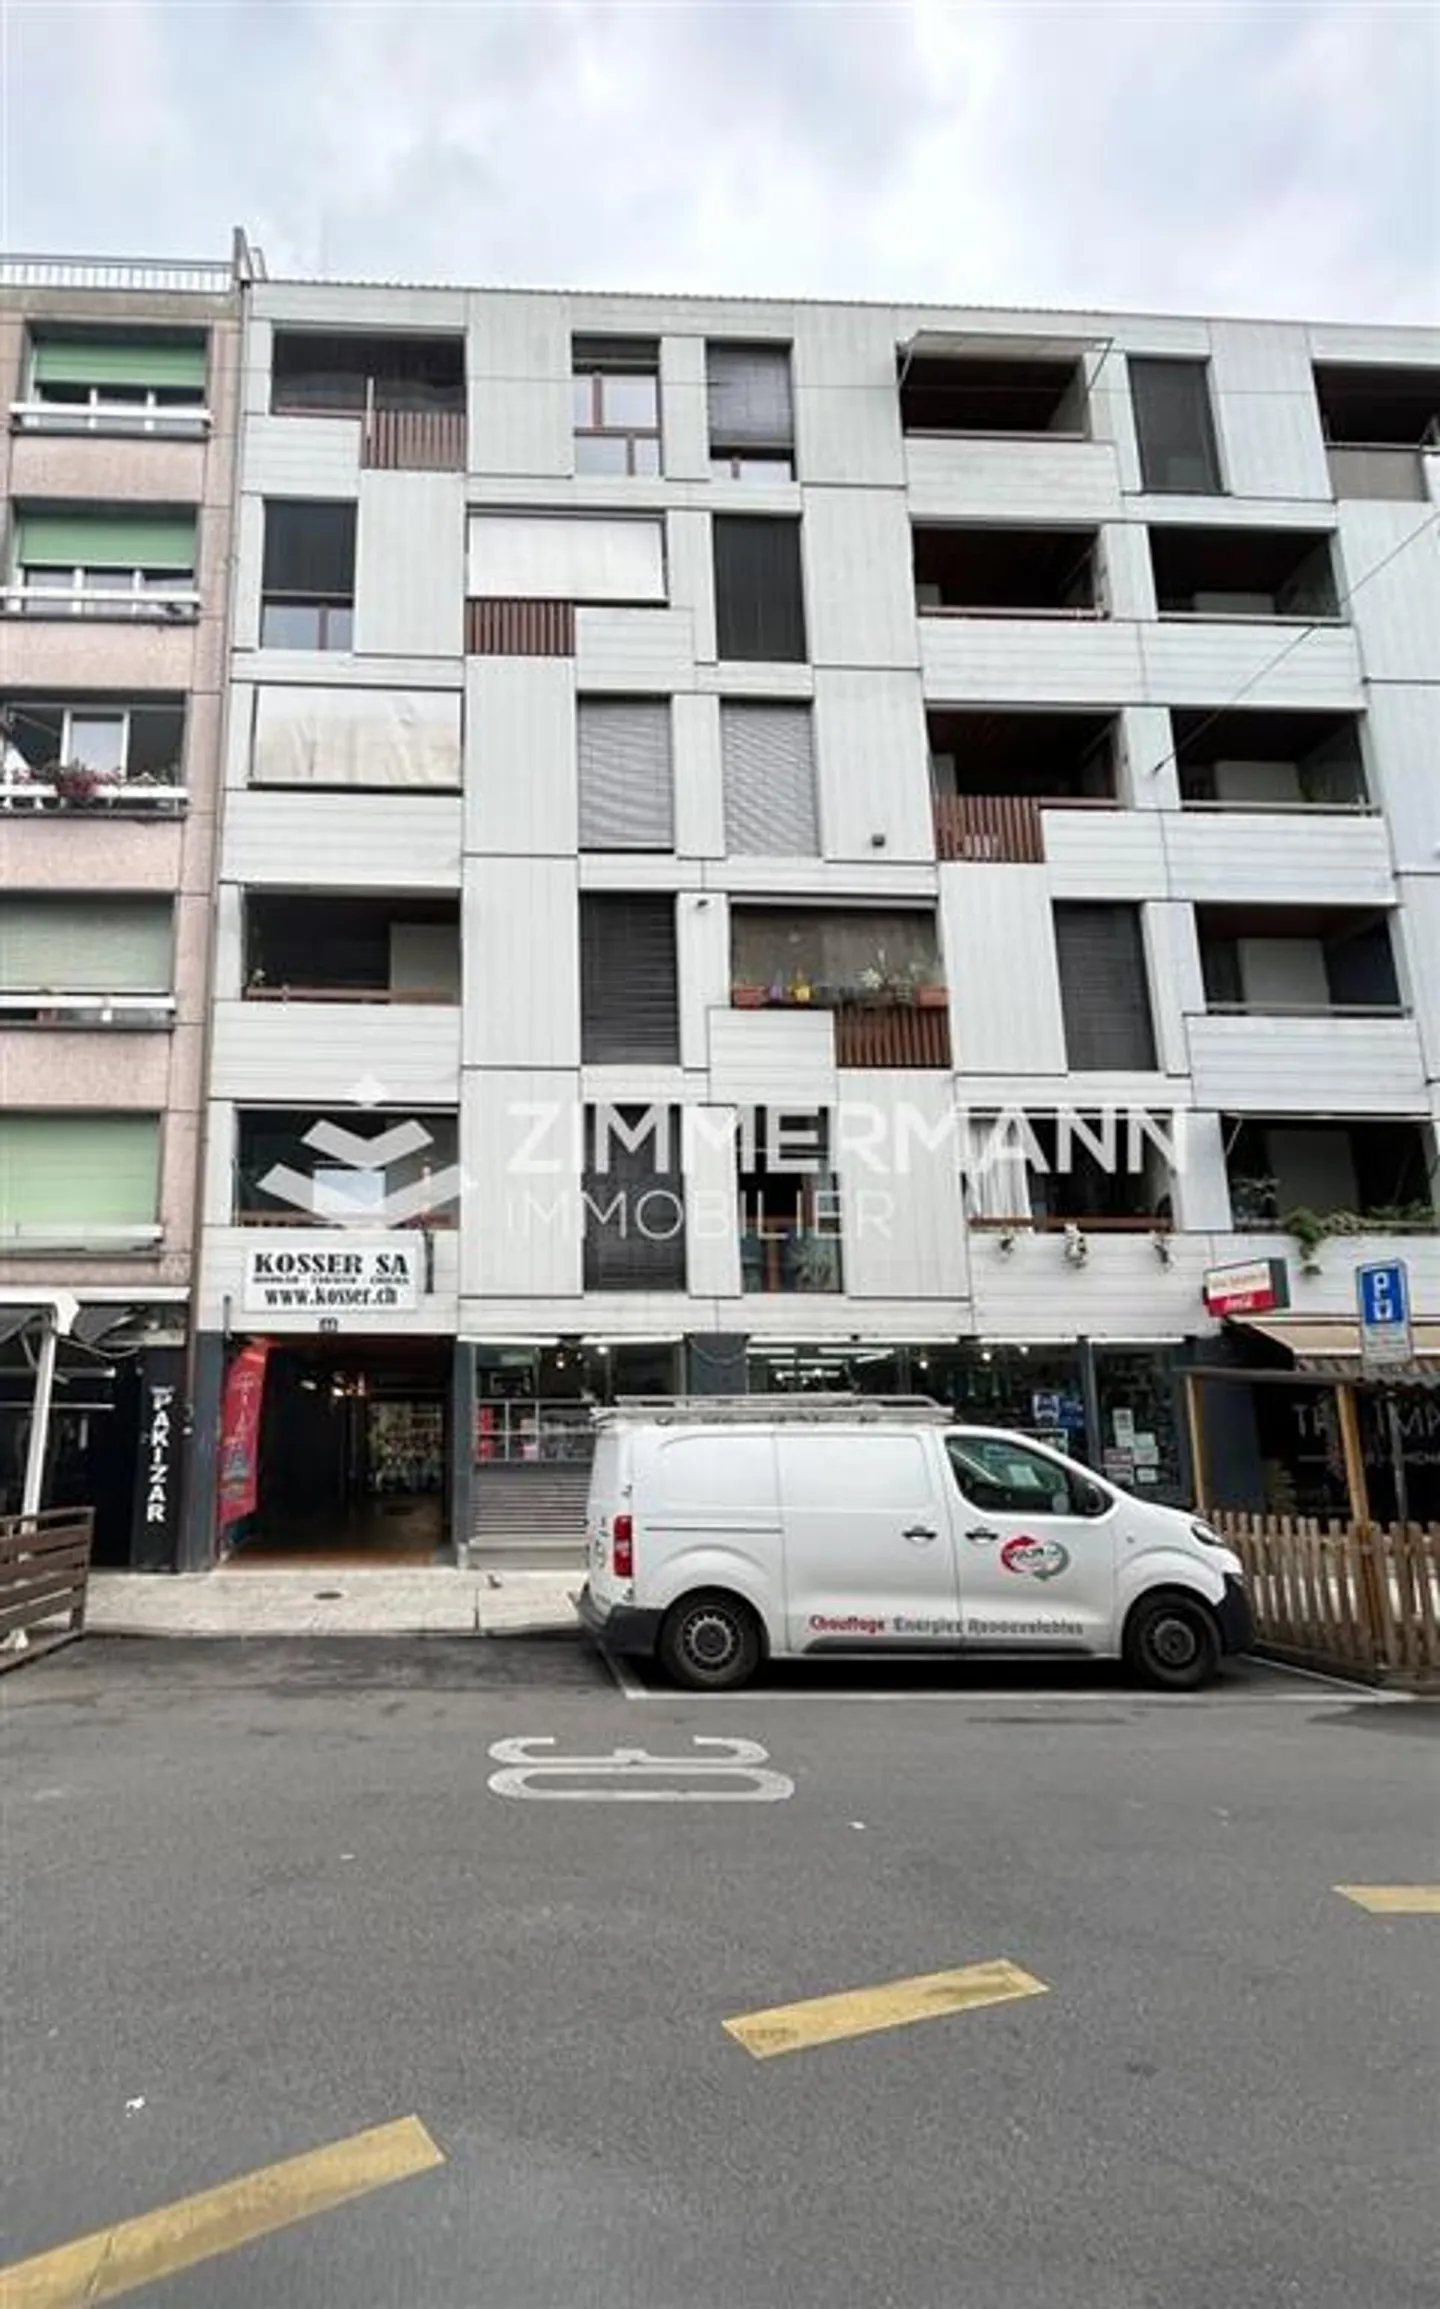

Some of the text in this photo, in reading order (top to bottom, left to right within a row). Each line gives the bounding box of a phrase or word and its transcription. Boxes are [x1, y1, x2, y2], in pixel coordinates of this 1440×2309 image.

[254, 1253, 409, 1275] KOSSER SA
[264, 1287, 398, 1306] www.kosser.ch
[146, 1391, 175, 1523] PAKIZAR
[809, 1614, 886, 1634] Chauffage
